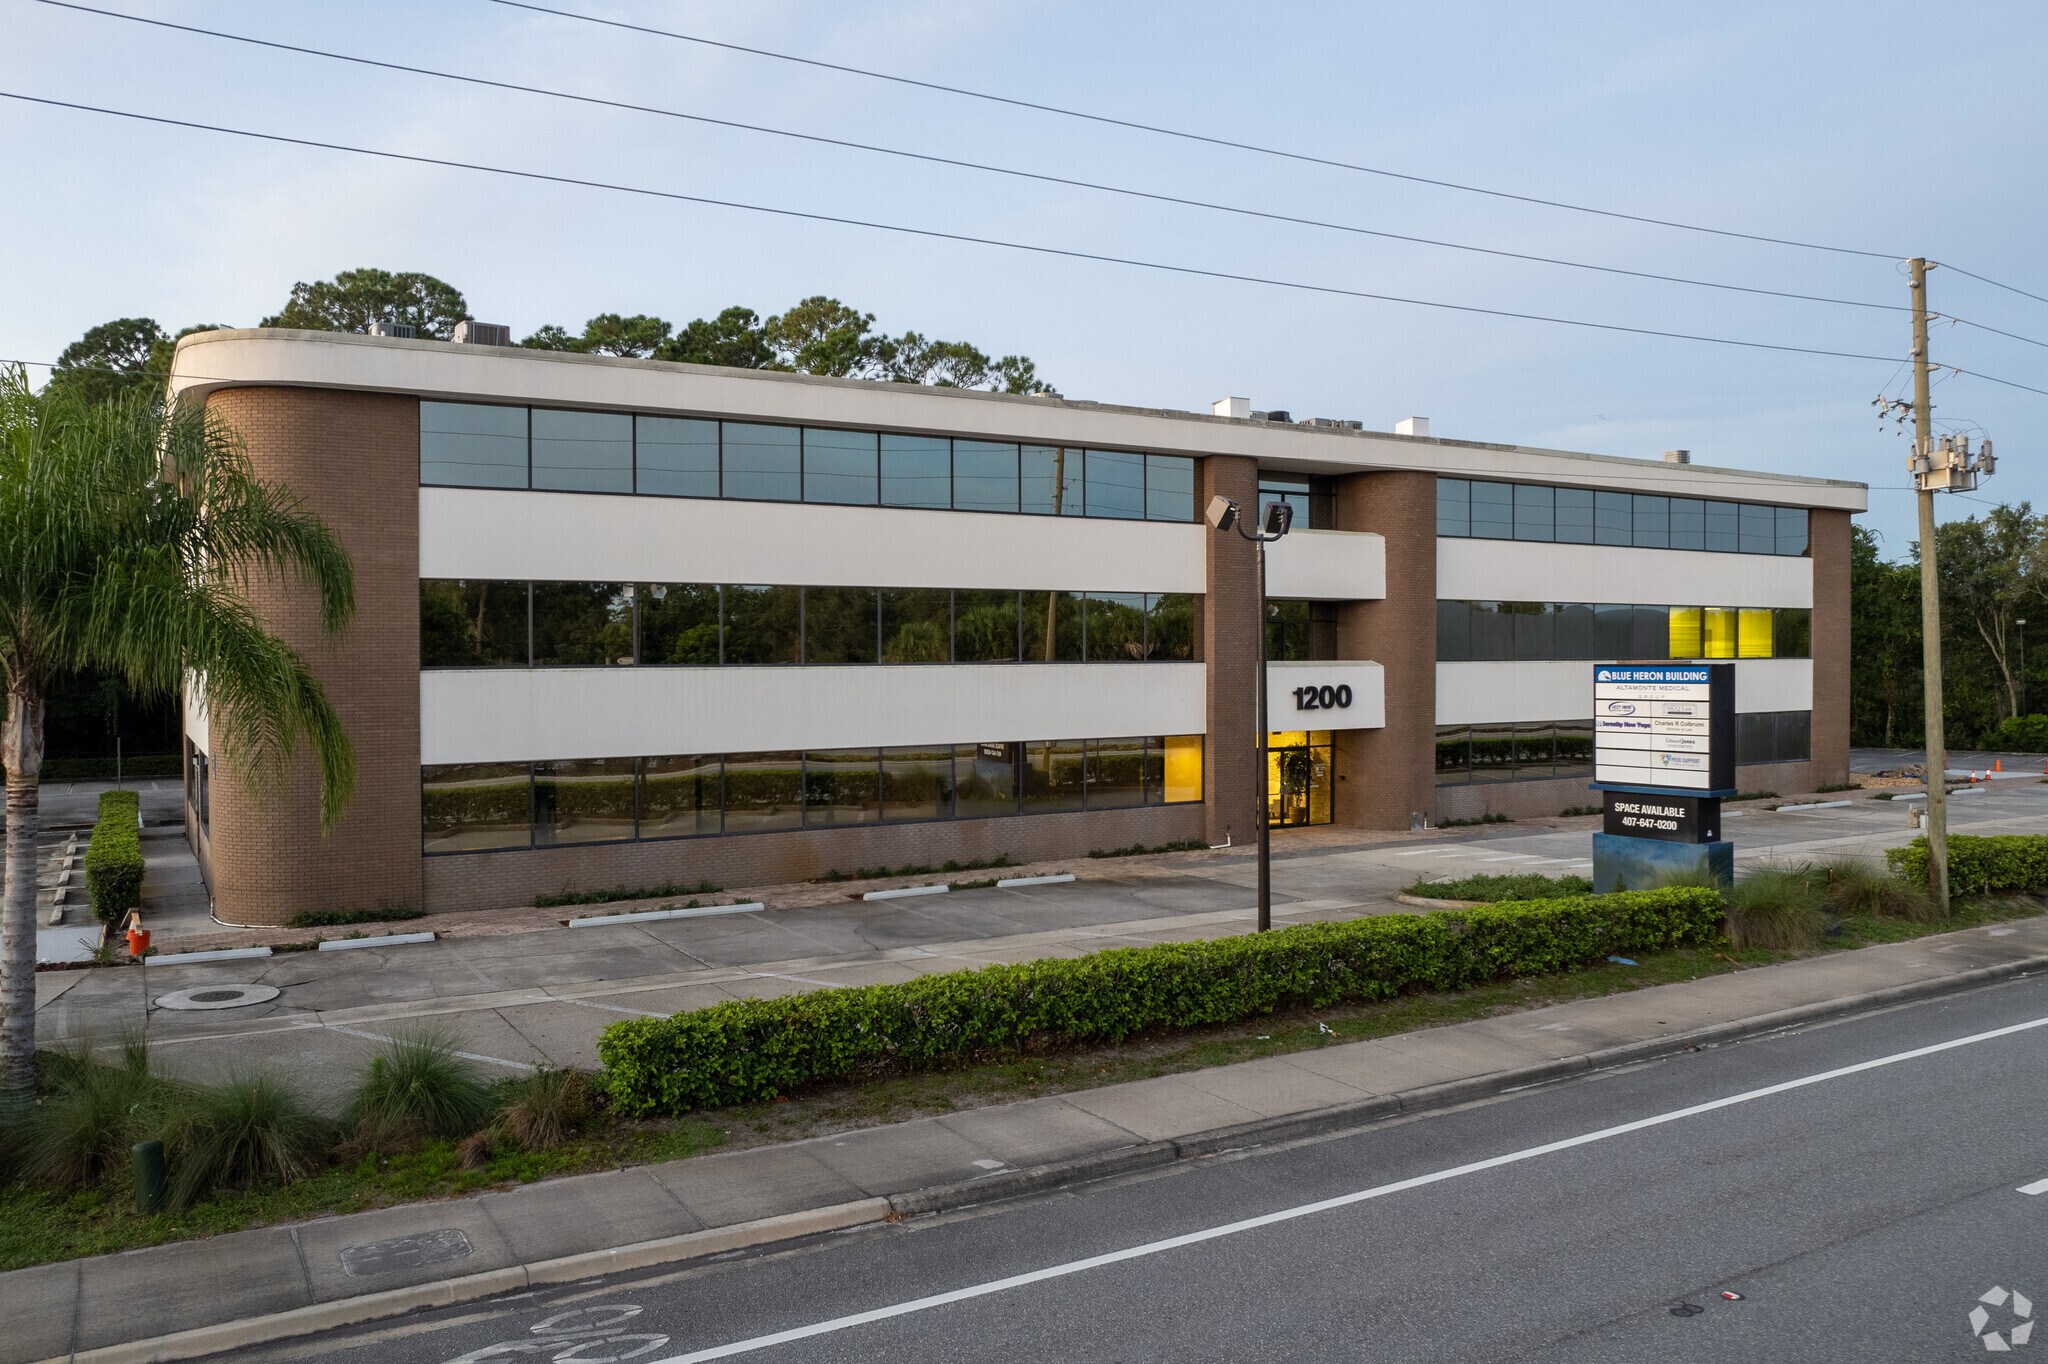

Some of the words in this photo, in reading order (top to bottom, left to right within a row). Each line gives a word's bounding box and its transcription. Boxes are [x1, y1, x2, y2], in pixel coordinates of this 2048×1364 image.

[1612, 671, 1632, 680] BLUE
[1633, 671, 1663, 681] HERON
[1666, 671, 1707, 681] BUILDING
[1292, 684, 1352, 711] 1200
[1637, 721, 1651, 729] Yoga
[1614, 802, 1640, 814] SPACE
[1641, 805, 1685, 818] AVAILABLE
[1622, 816, 1677, 831] 407-647-0200
